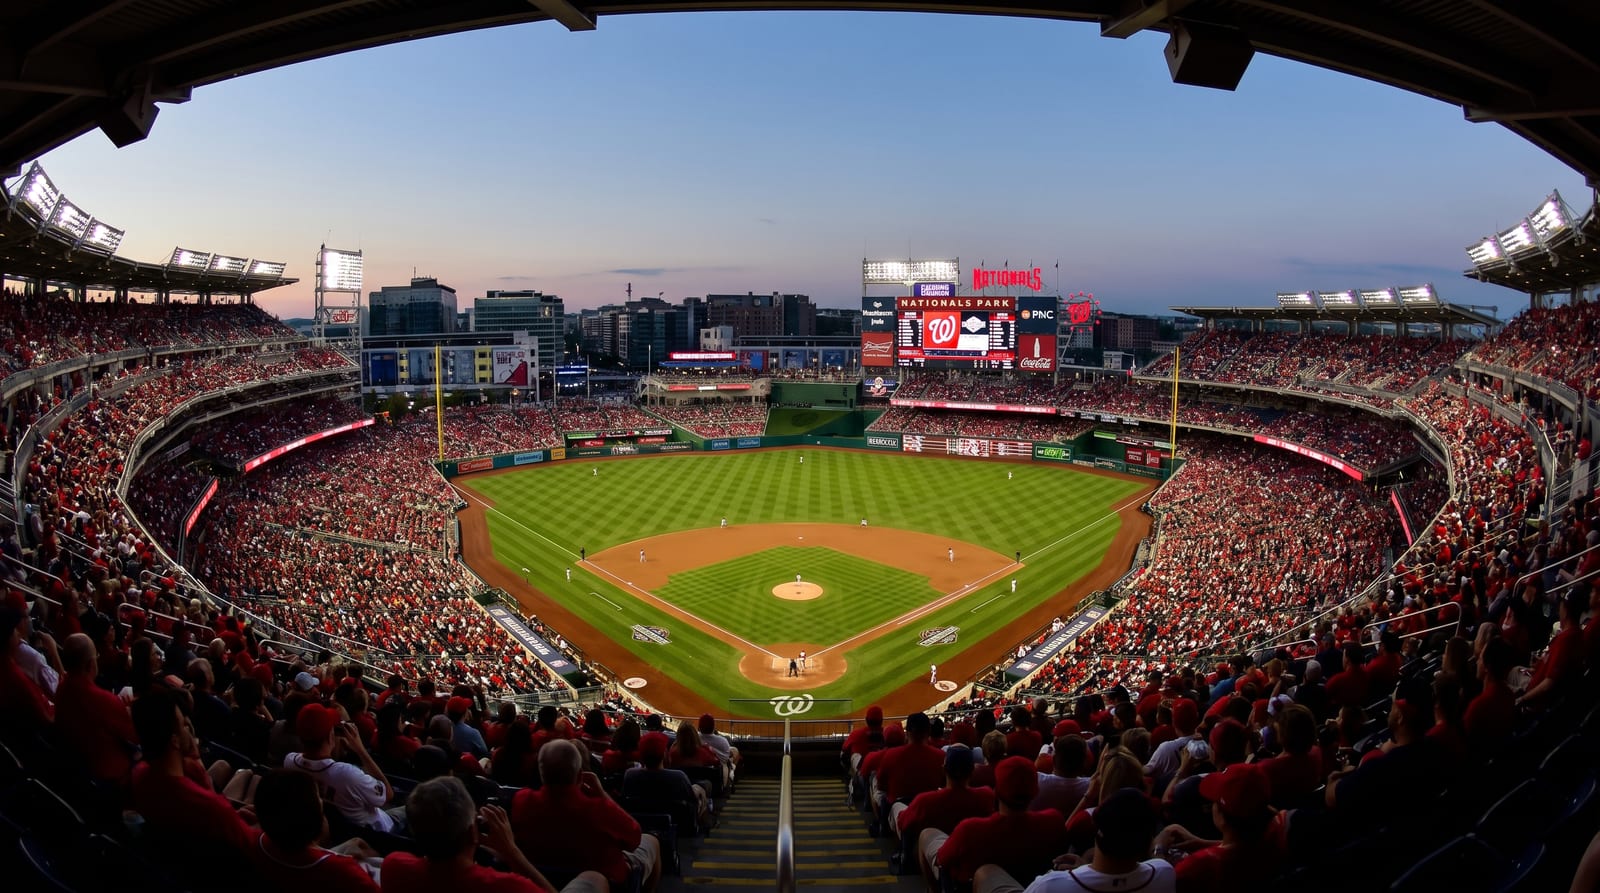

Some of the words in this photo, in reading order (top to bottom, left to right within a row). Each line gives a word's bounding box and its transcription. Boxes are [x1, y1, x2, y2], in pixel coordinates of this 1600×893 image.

[973, 267, 1042, 292] NATIONALS
[901, 299, 971, 307] NATIONALS
[977, 299, 1009, 307] PARK
[1032, 310, 1054, 319] PNC
[928, 315, 956, 344] W
